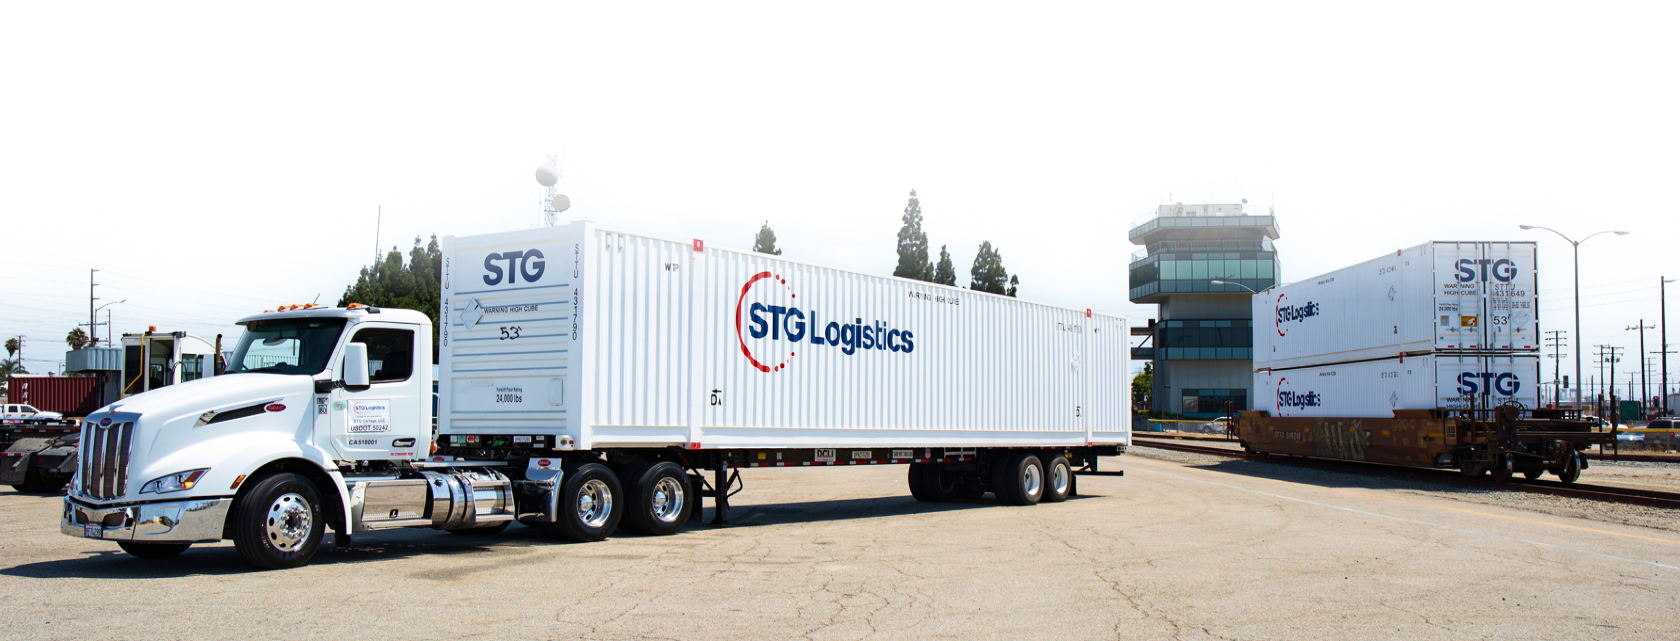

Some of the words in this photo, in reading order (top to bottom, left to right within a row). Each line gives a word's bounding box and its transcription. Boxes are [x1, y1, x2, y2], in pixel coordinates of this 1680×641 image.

[483, 248, 545, 286] STG
[1454, 259, 1517, 282] STG
[908, 290, 931, 301] WRING
[1278, 304, 1291, 323] STG
[1292, 301, 1320, 323] Logistics
[749, 302, 806, 342] STG
[810, 310, 914, 355] Logistics
[1457, 372, 1520, 396] STG
[496, 394, 513, 404] 24,000
[514, 394, 522, 403] lbs
[1279, 391, 1292, 407] STG
[1292, 391, 1320, 410] Logistics
